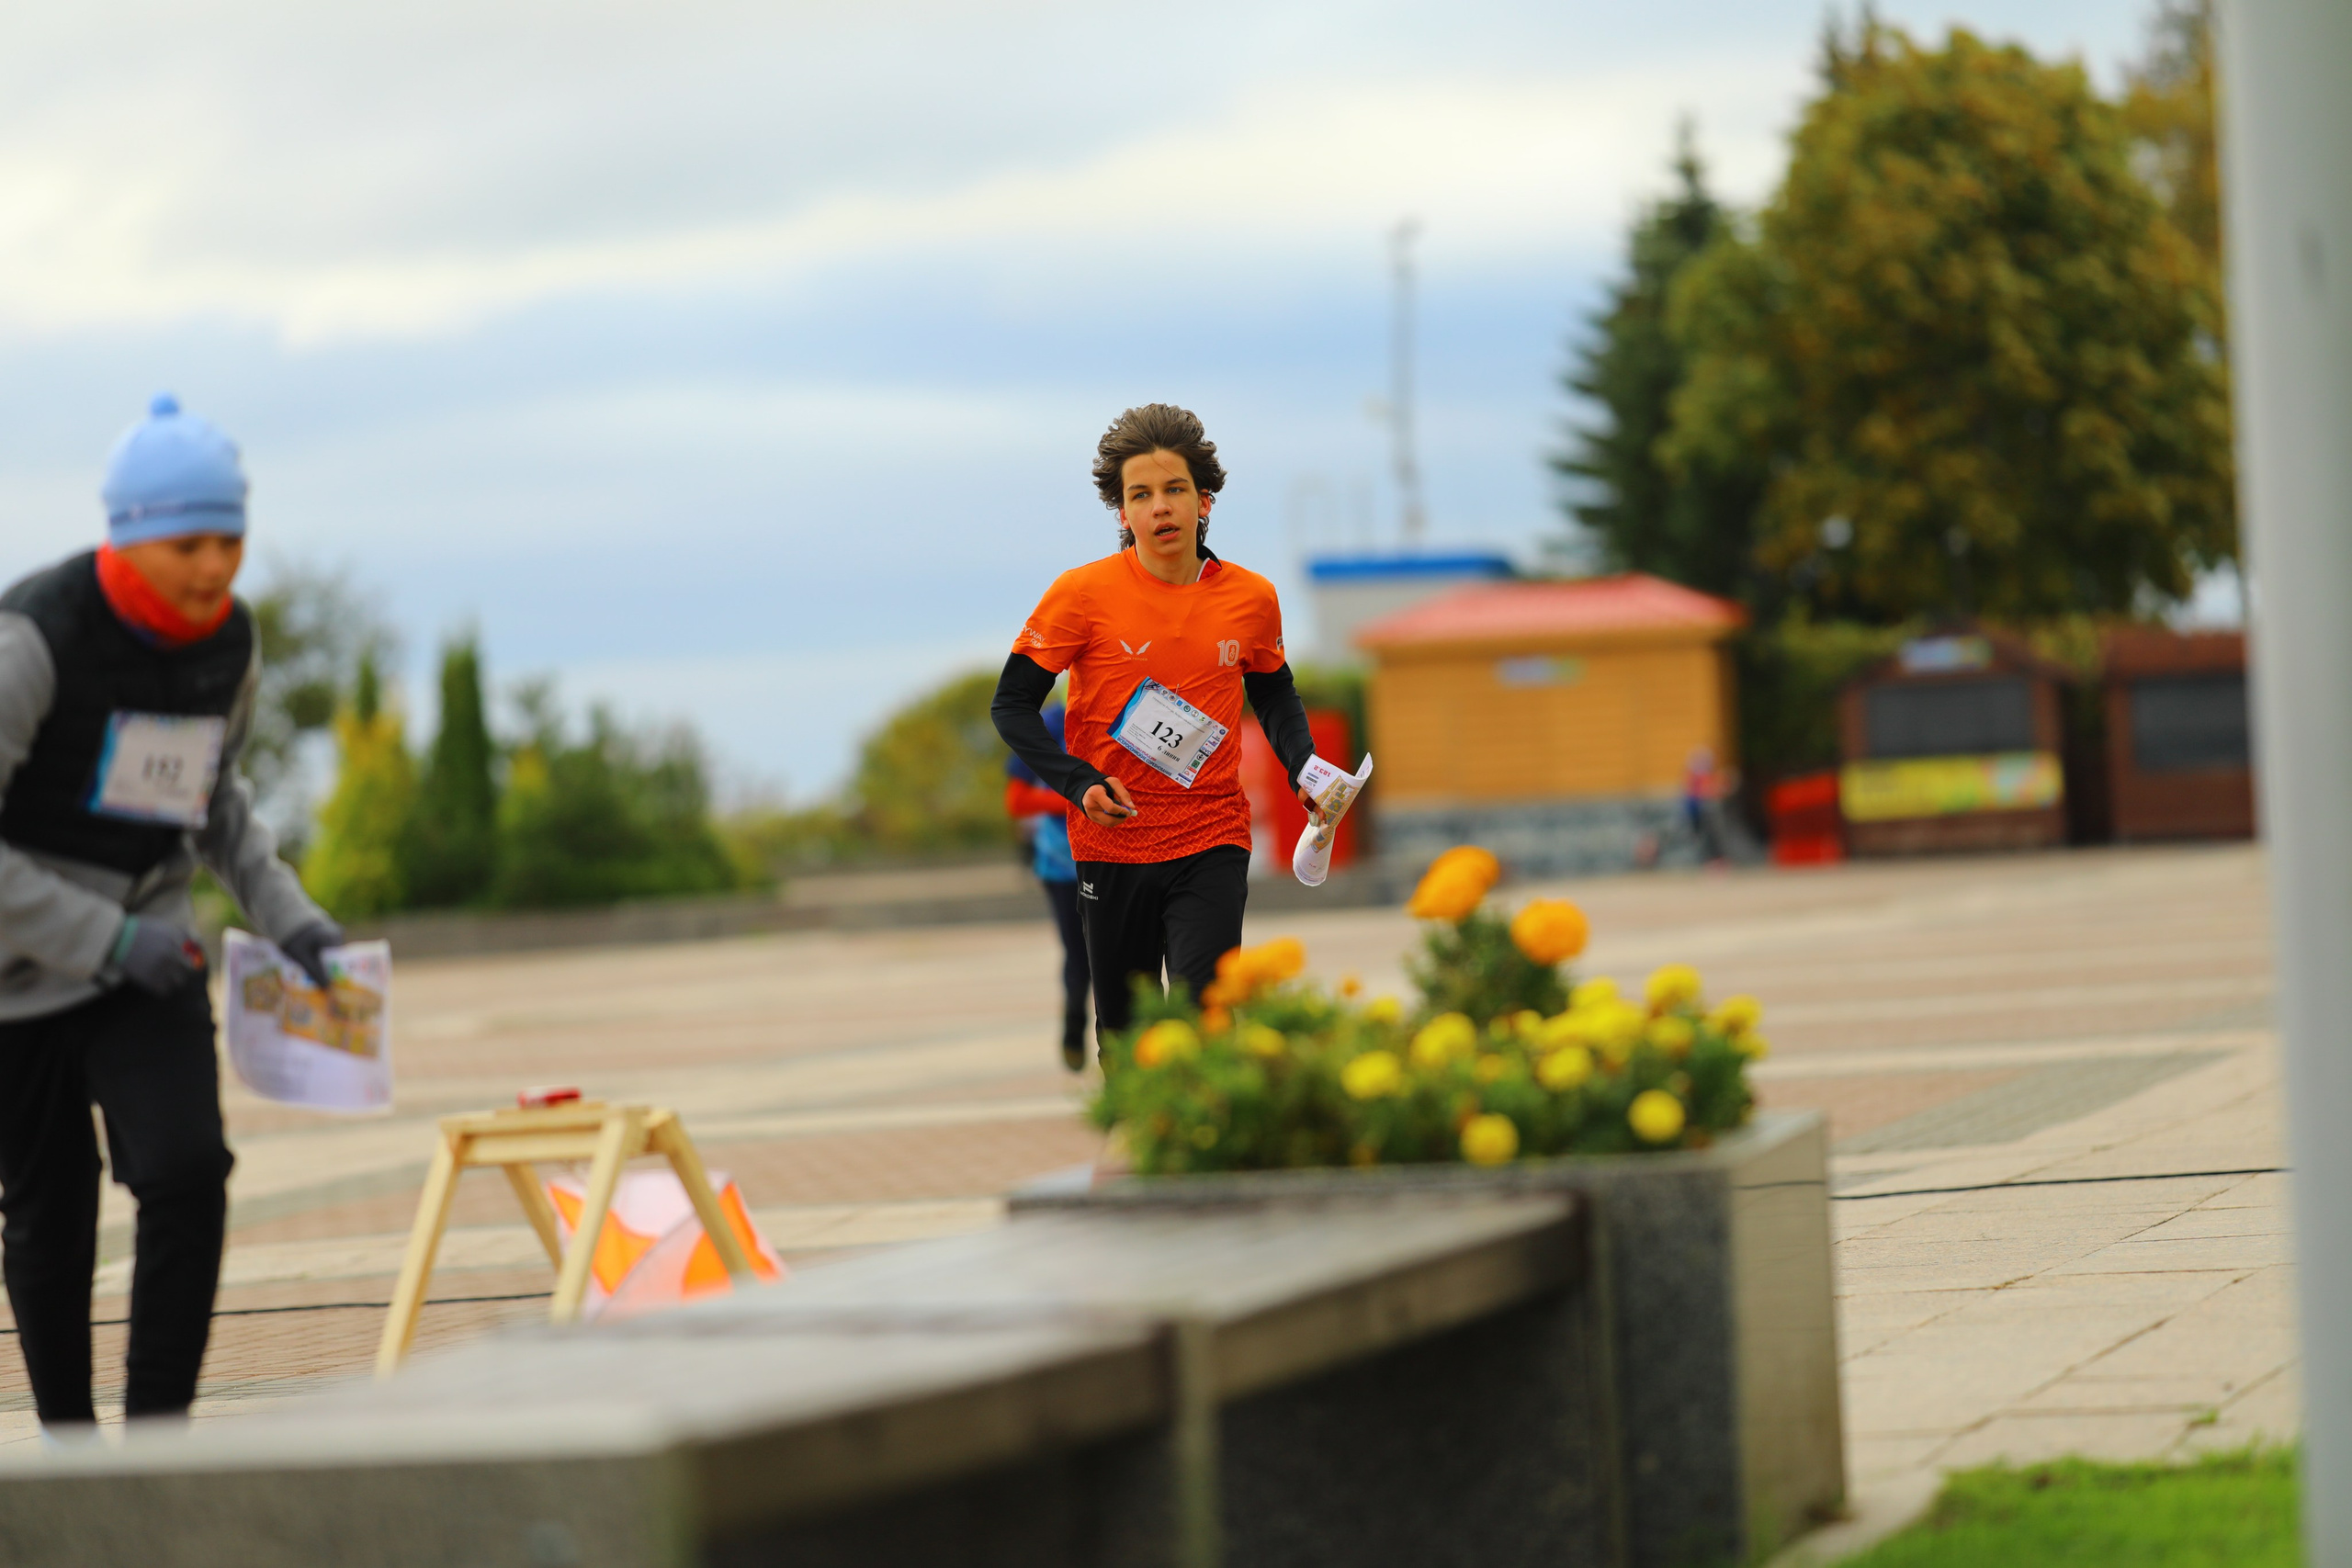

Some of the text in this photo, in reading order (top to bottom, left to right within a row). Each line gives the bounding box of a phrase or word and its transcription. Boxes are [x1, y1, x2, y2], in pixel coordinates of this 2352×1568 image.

[1216, 639, 1240, 667] 10
[1150, 720, 1183, 749] 123
[1162, 750, 1181, 762] линия
